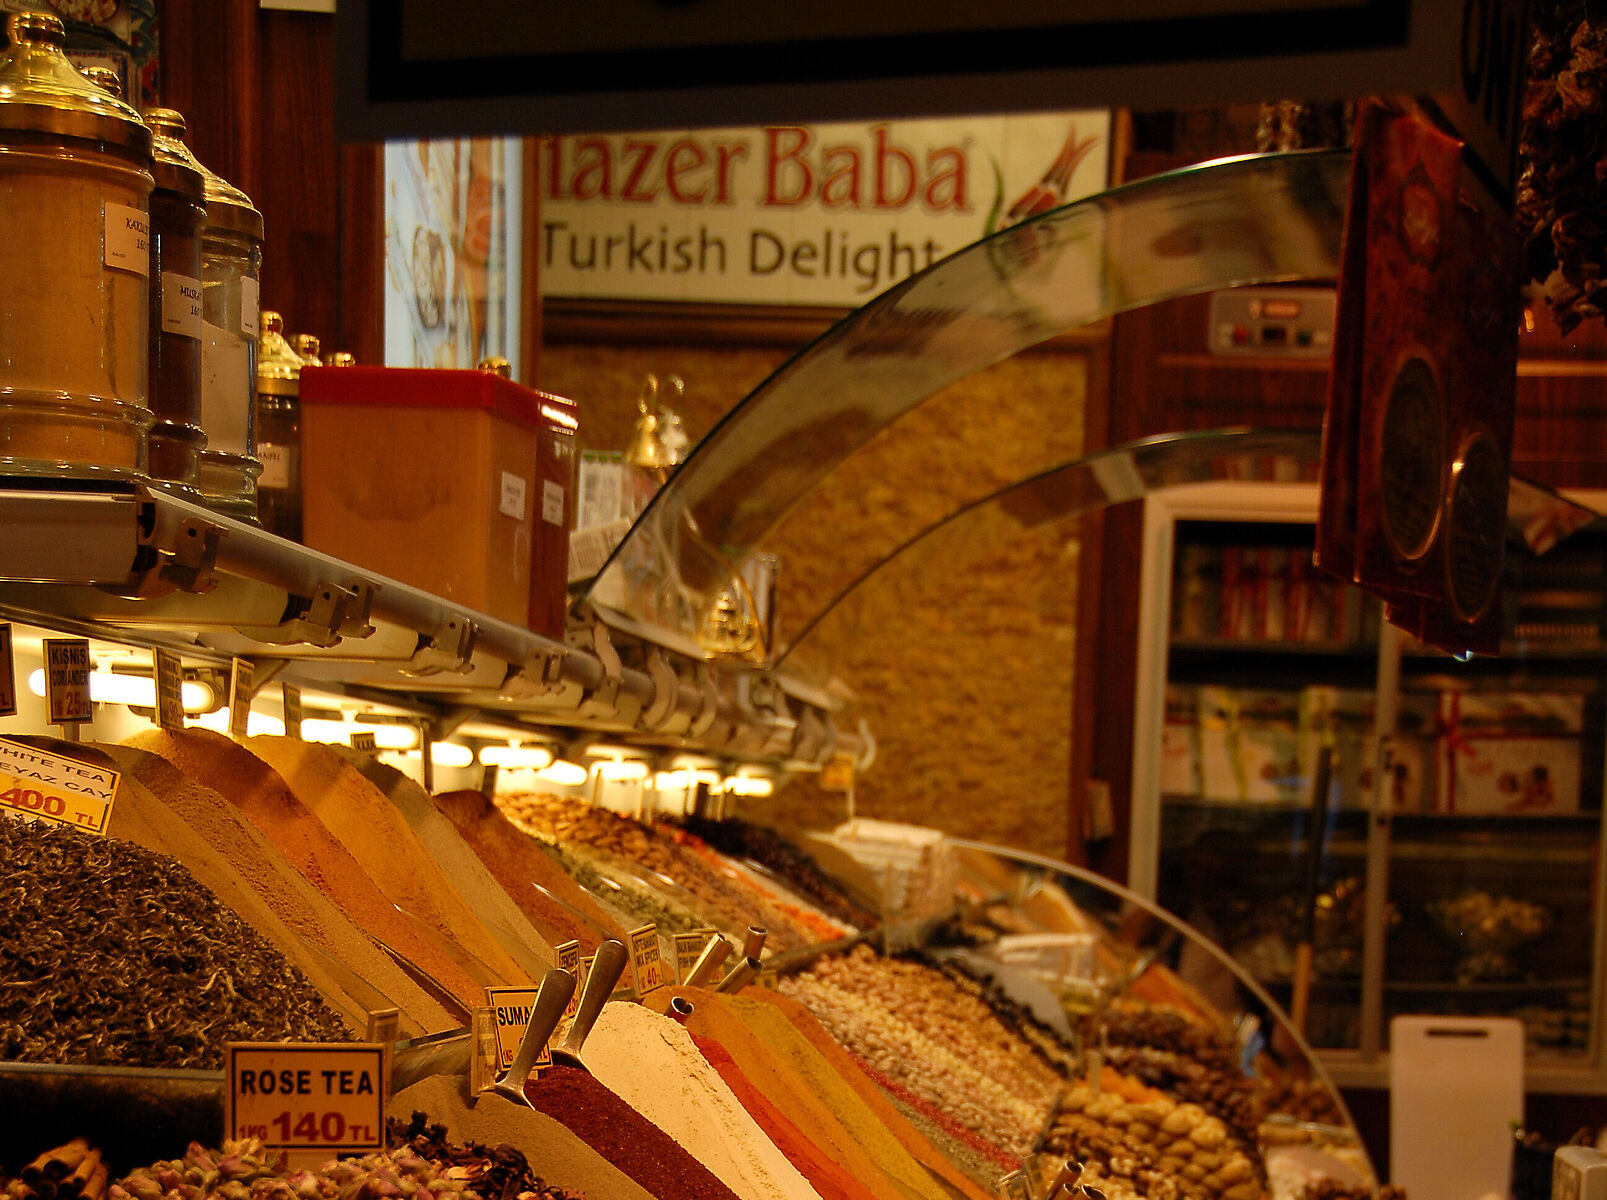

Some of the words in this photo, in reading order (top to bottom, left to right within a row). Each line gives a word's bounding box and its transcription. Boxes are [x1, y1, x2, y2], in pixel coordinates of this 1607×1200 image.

[759, 124, 972, 213] Baba
[543, 221, 727, 275] Turkish
[749, 227, 943, 294] Delight
[0, 747, 55, 768] HITE
[62, 764, 105, 783] TEA
[0, 761, 58, 785] EYAZ
[0, 788, 66, 817] 400
[75, 811, 99, 828] TL
[497, 1006, 534, 1026] SUMA
[240, 1070, 312, 1095] ROSE
[321, 1070, 374, 1095] TEA
[239, 1124, 268, 1141] 1KG
[272, 1111, 346, 1142] 140
[349, 1124, 377, 1141] TL
